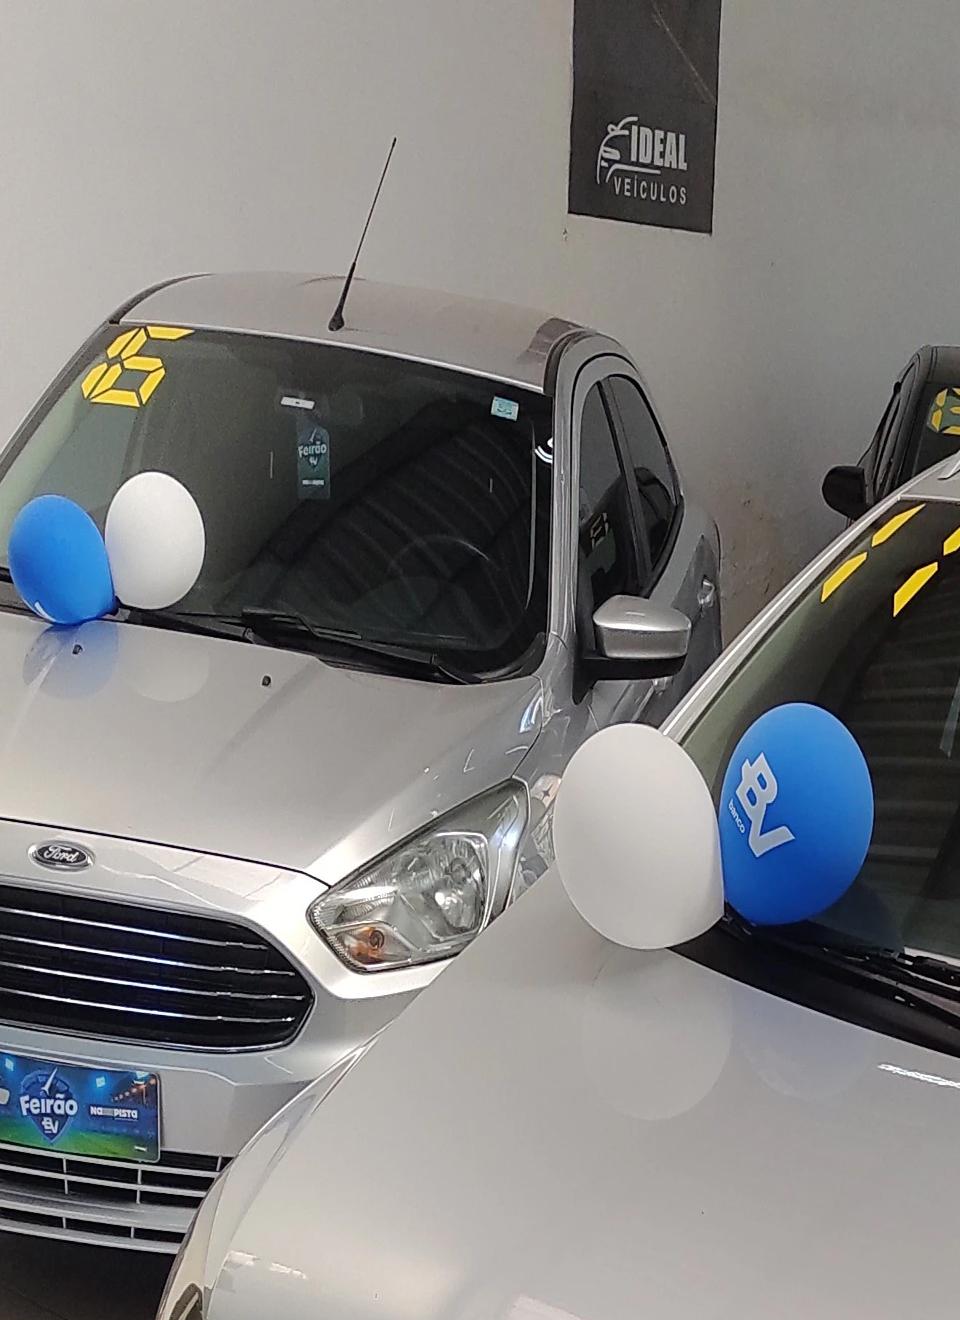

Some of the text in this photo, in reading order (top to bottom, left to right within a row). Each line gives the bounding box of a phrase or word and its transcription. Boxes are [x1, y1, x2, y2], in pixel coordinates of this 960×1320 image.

[629, 125, 688, 171] IDEAL
[613, 175, 687, 205] VEÍCULOS
[81, 325, 196, 408] 16
[728, 798, 746, 835] banco
[43, 845, 80, 863] Ford
[20, 1093, 78, 1116] Feirão
